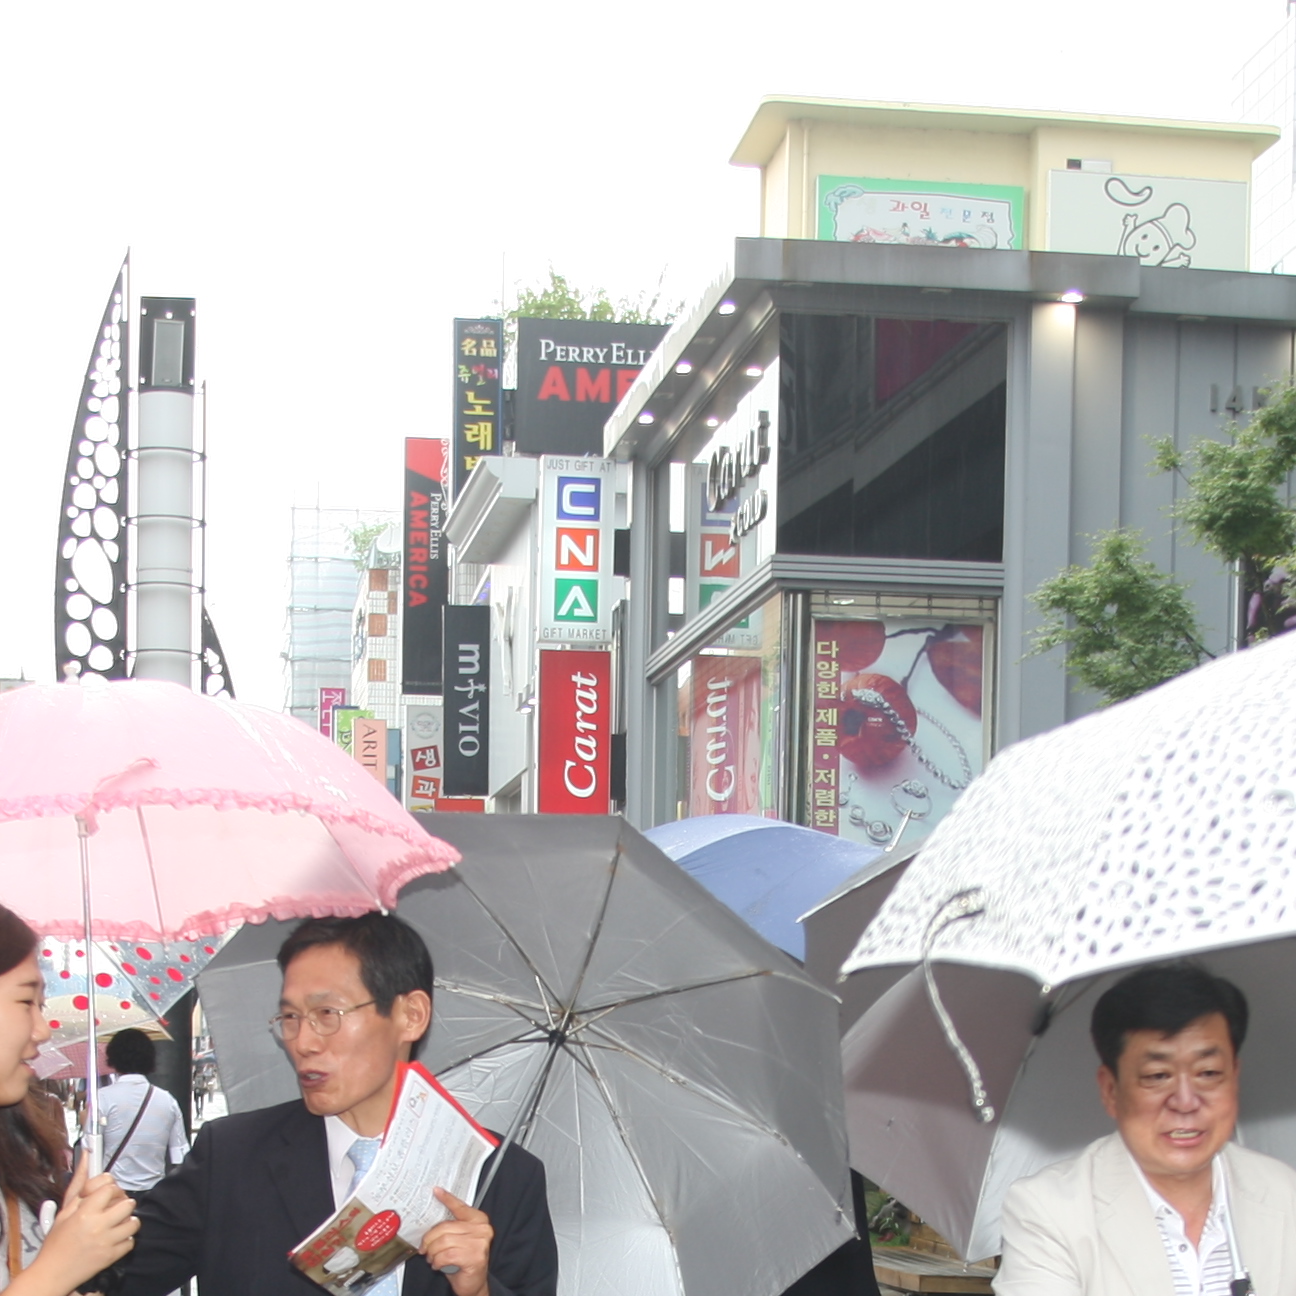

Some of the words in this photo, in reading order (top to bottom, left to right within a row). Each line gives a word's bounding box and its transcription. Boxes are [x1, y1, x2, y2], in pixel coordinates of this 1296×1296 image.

[889, 199, 931, 220] 과일
[460, 337, 497, 358] 名品
[538, 338, 608, 364] PERRY
[546, 459, 570, 471] JUST
[574, 460, 594, 472] GIFT
[599, 461, 611, 473] AT
[429, 492, 440, 528] PERRY
[408, 490, 429, 608] AMERICA
[430, 529, 440, 560] ELLIS
[543, 627, 563, 639] GIFT
[568, 627, 607, 640] MARKET
[815, 640, 839, 700] 다양한
[564, 671, 598, 799] Carat
[814, 707, 839, 747] 제품
[413, 748, 438, 804] 생과
[814, 768, 837, 828] 저렴한
